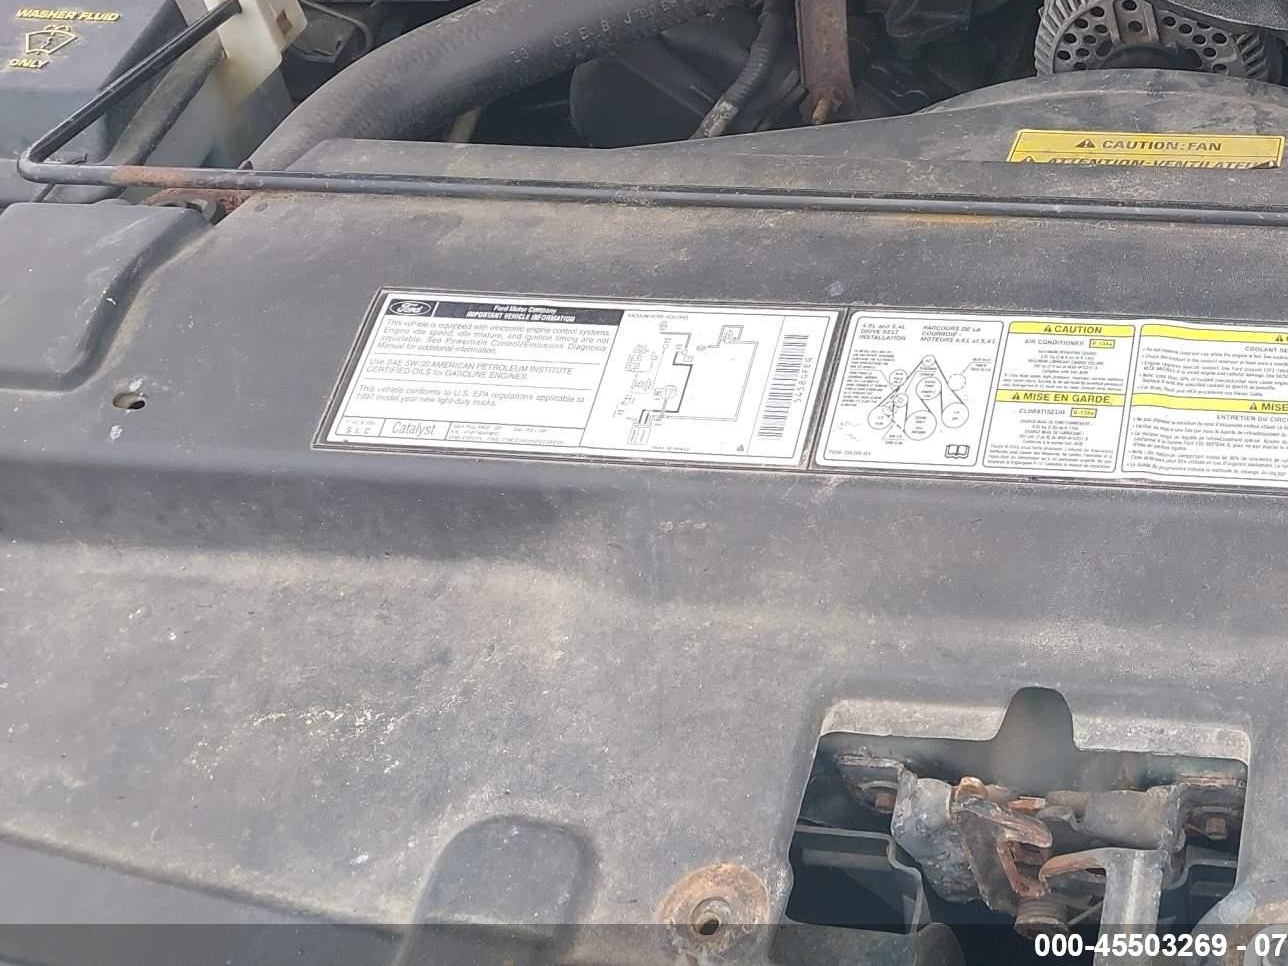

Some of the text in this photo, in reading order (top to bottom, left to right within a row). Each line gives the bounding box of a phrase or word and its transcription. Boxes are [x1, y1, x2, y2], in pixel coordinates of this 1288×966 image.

[16, 9, 120, 22] WASHER FLUID
[9, 57, 50, 69] ONLY
[1188, 142, 1222, 151] FAN
[397, 302, 424, 313] Ford
[509, 305, 528, 313] Motor
[528, 307, 558, 316] Company
[466, 310, 576, 324] IMPORTANT VEHICLE INFORMATION
[438, 323, 472, 332] equipped
[490, 325, 526, 333] electronic
[526, 327, 551, 336] engine
[1054, 325, 1102, 334] CAUTION
[366, 365, 410, 374] CERTIFIED
[444, 370, 487, 378] GASOLINE
[430, 361, 475, 370] AMERICAN
[475, 362, 529, 372] PETROLEUM
[529, 365, 575, 375] INSTITUTE
[1023, 393, 1111, 404] MISE EN GARDE
[1261, 403, 1288, 412] MISE
[392, 421, 436, 437] Catalyst
